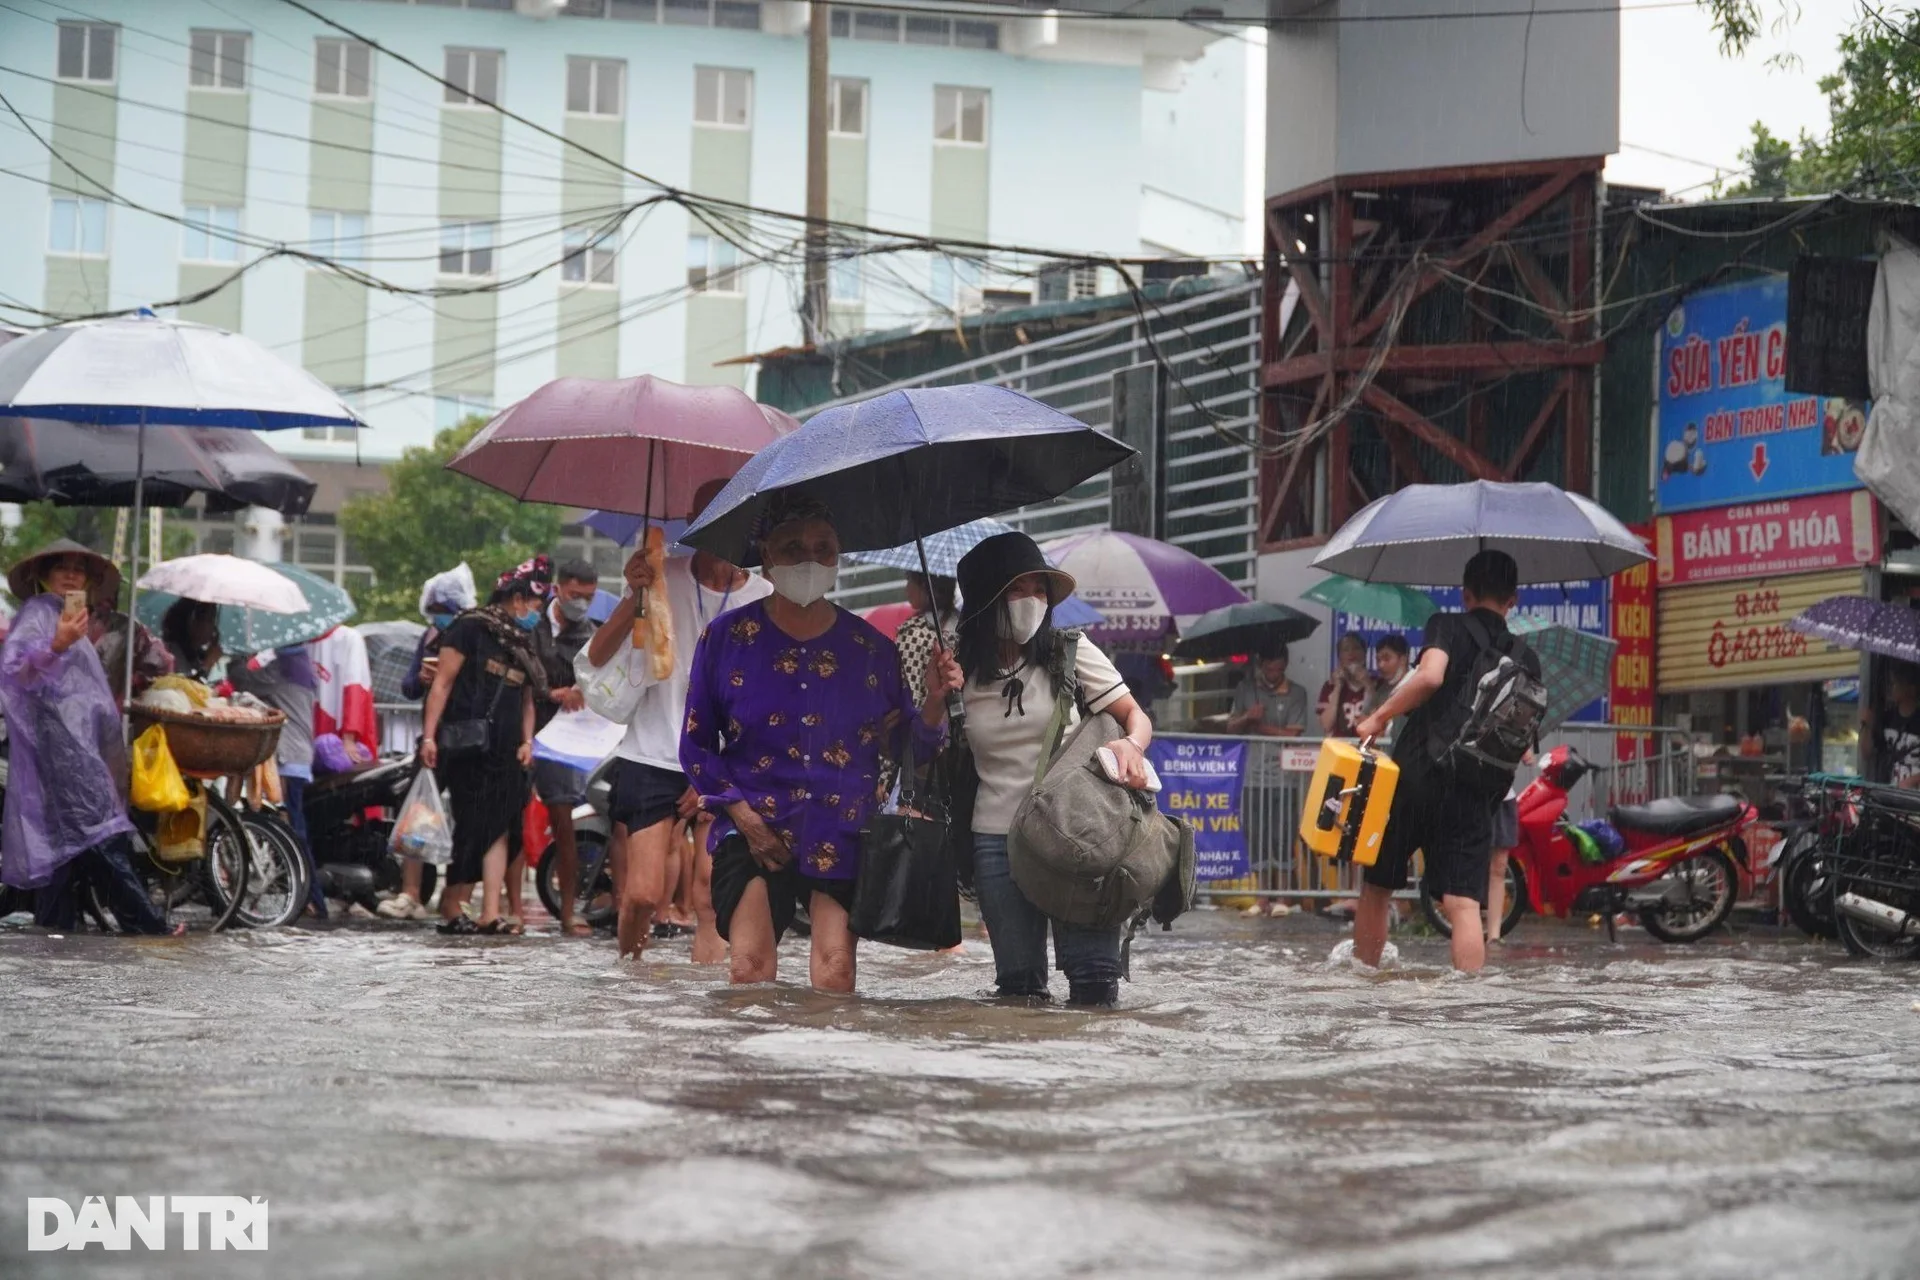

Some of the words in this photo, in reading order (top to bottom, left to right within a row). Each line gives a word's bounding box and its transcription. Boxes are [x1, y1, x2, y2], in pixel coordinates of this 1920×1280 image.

[1737, 404, 1784, 438] TRONG
[1682, 523, 1732, 560] BÁN
[1736, 521, 1782, 559] TẠP
[1787, 510, 1841, 549] HÓA
[1177, 745, 1195, 757] BỘ
[1198, 745, 1207, 756] Y
[1164, 759, 1196, 773] BỆNH
[1200, 759, 1225, 773] VIỆN
[1228, 761, 1237, 772] K
[1206, 793, 1230, 809] XE
